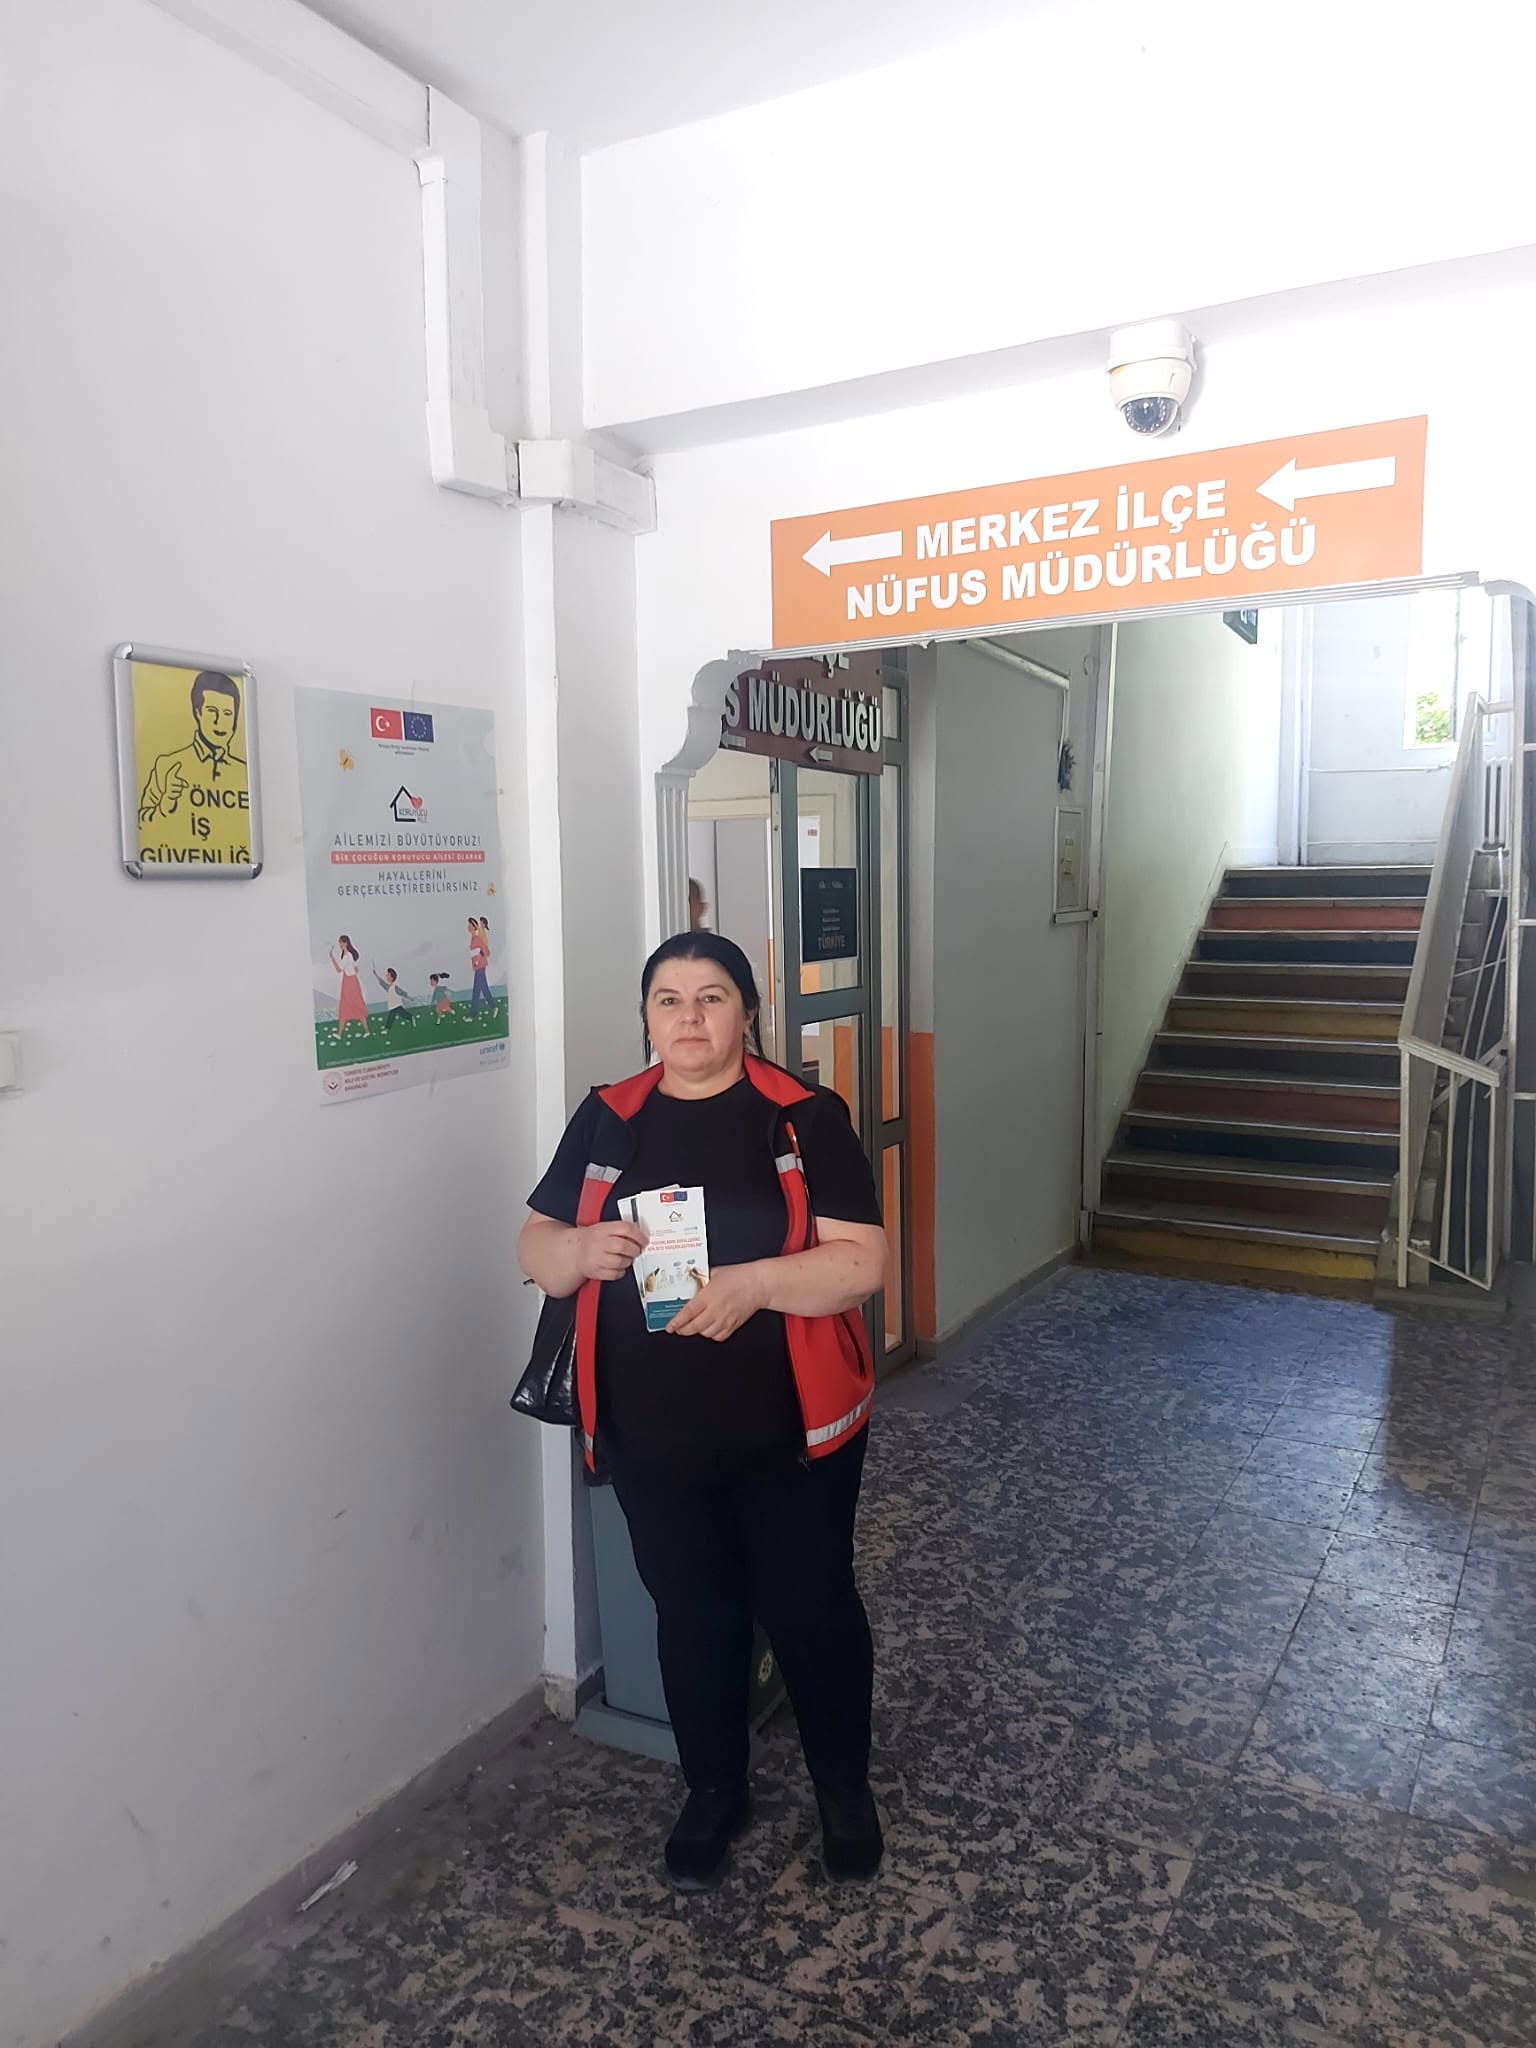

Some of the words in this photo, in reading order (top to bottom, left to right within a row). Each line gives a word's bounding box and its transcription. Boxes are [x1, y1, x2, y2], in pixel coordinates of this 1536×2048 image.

[916, 498, 1100, 560] MERKEZ
[1116, 479, 1226, 534] İLÇE
[847, 573, 987, 620] NÜFUS
[1002, 516, 1316, 601] MÜDÜRLÜĞÜ
[749, 670, 881, 753] MÜDÜRLÜĞÜ
[189, 784, 250, 810] ÖNCE
[191, 812, 211, 841] İŞ
[334, 831, 391, 847] AİLEMİZİ
[335, 852, 349, 862] BİR
[352, 852, 389, 863] ÇOCUĞUN
[392, 854, 431, 862] KORUYUCU
[457, 853, 483, 861] OLARAK
[378, 868, 446, 881] HAYALLERİNİ
